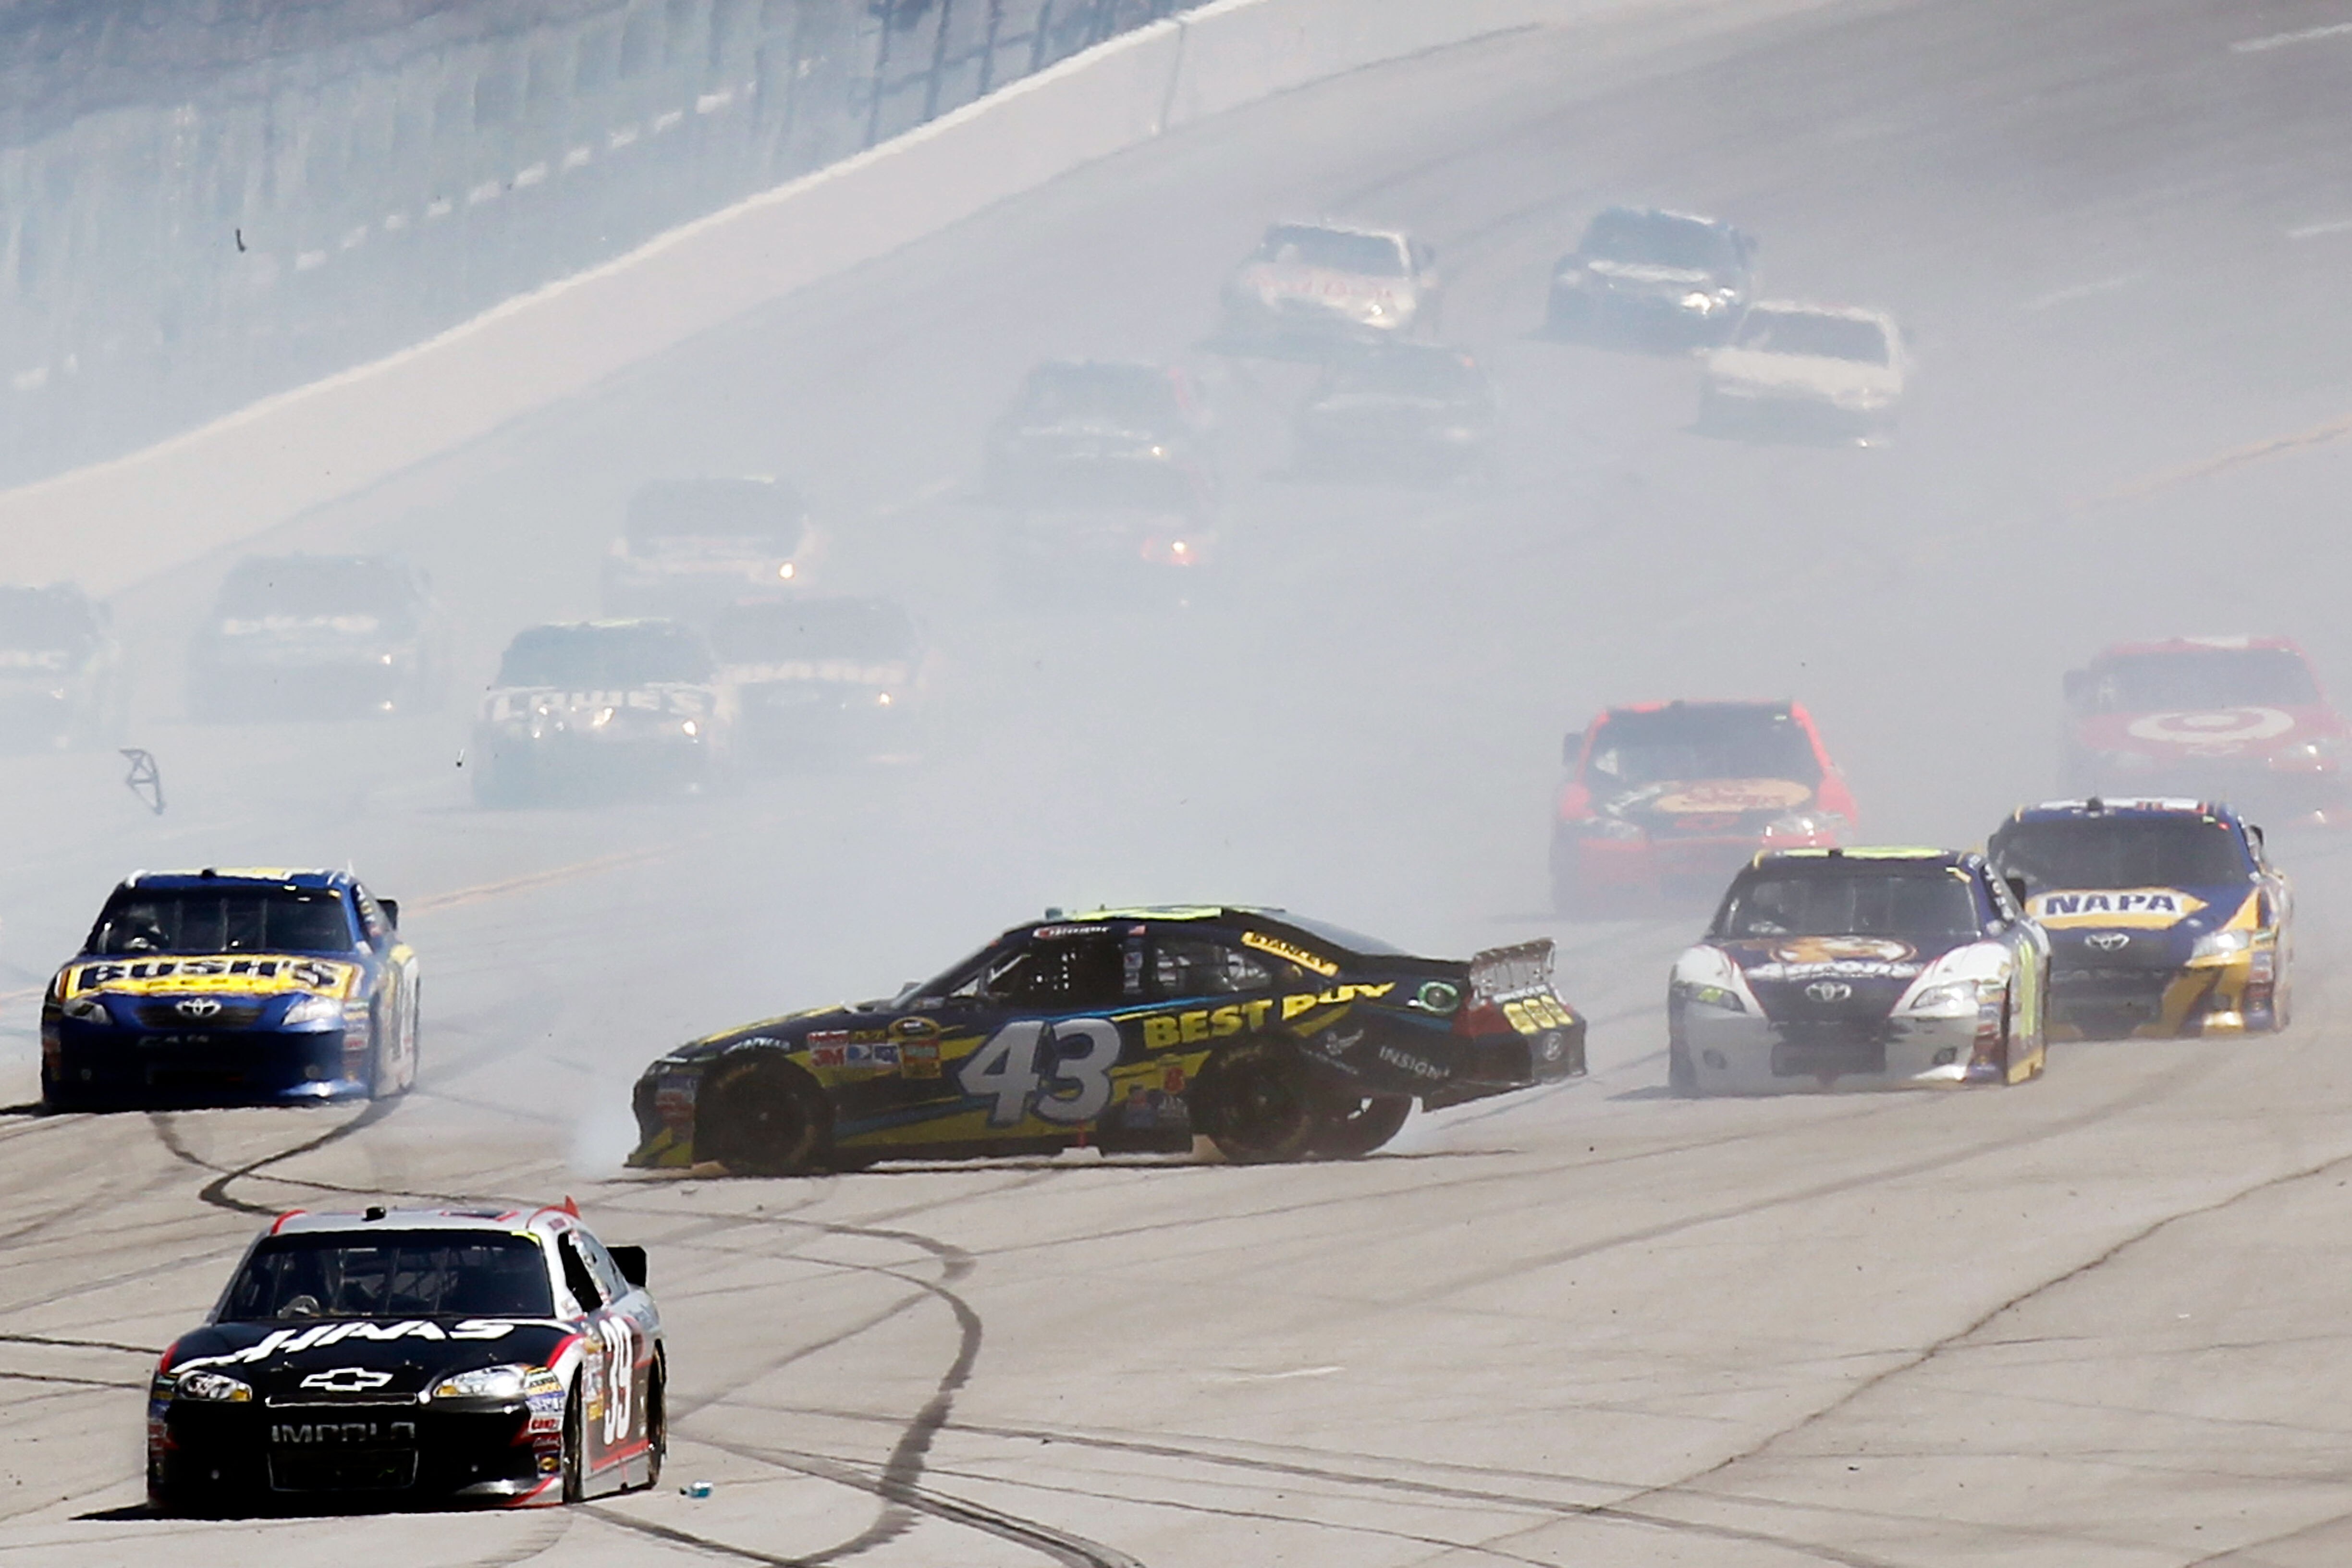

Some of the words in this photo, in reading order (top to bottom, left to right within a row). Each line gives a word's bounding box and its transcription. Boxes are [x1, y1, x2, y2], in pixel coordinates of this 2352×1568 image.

[2046, 894, 2176, 915] NAPA
[1143, 999, 1273, 1049] BEST
[959, 1017, 1122, 1123] 43
[599, 1317, 632, 1445] 39
